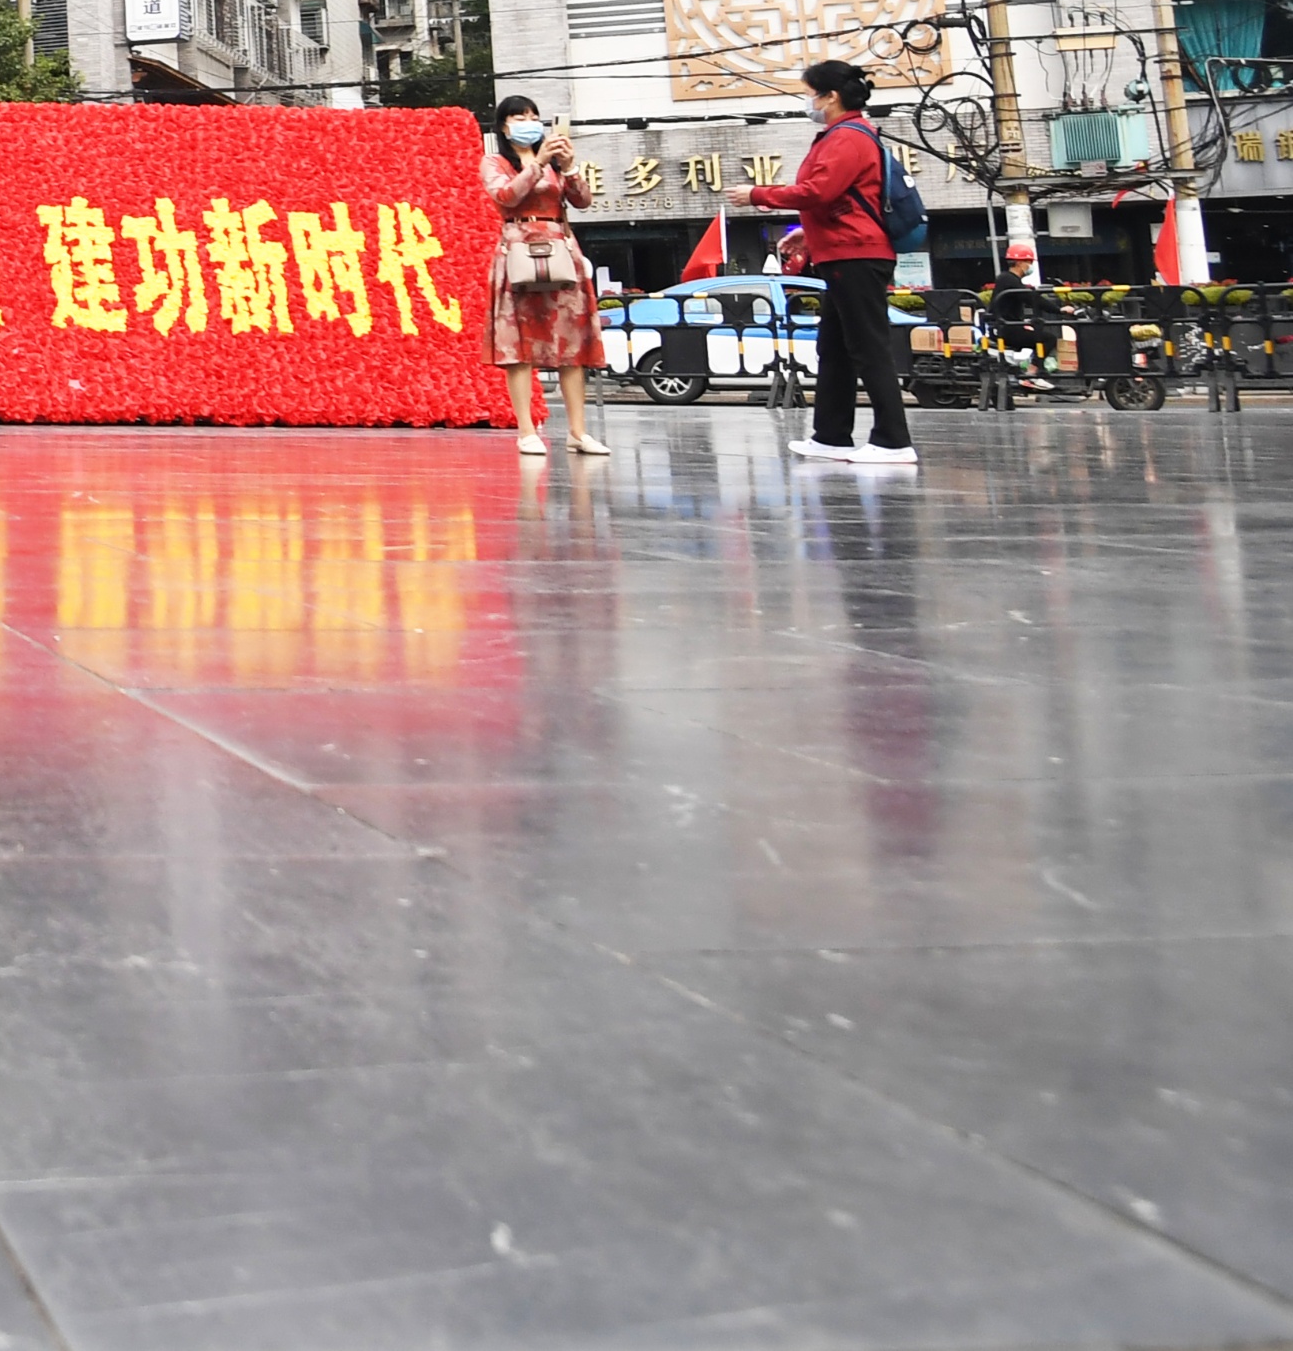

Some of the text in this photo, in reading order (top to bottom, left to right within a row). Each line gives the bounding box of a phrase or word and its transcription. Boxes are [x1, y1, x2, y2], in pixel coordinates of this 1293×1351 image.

[579, 196, 674, 213] 5935578
[36, 196, 463, 337] 建功新时代
